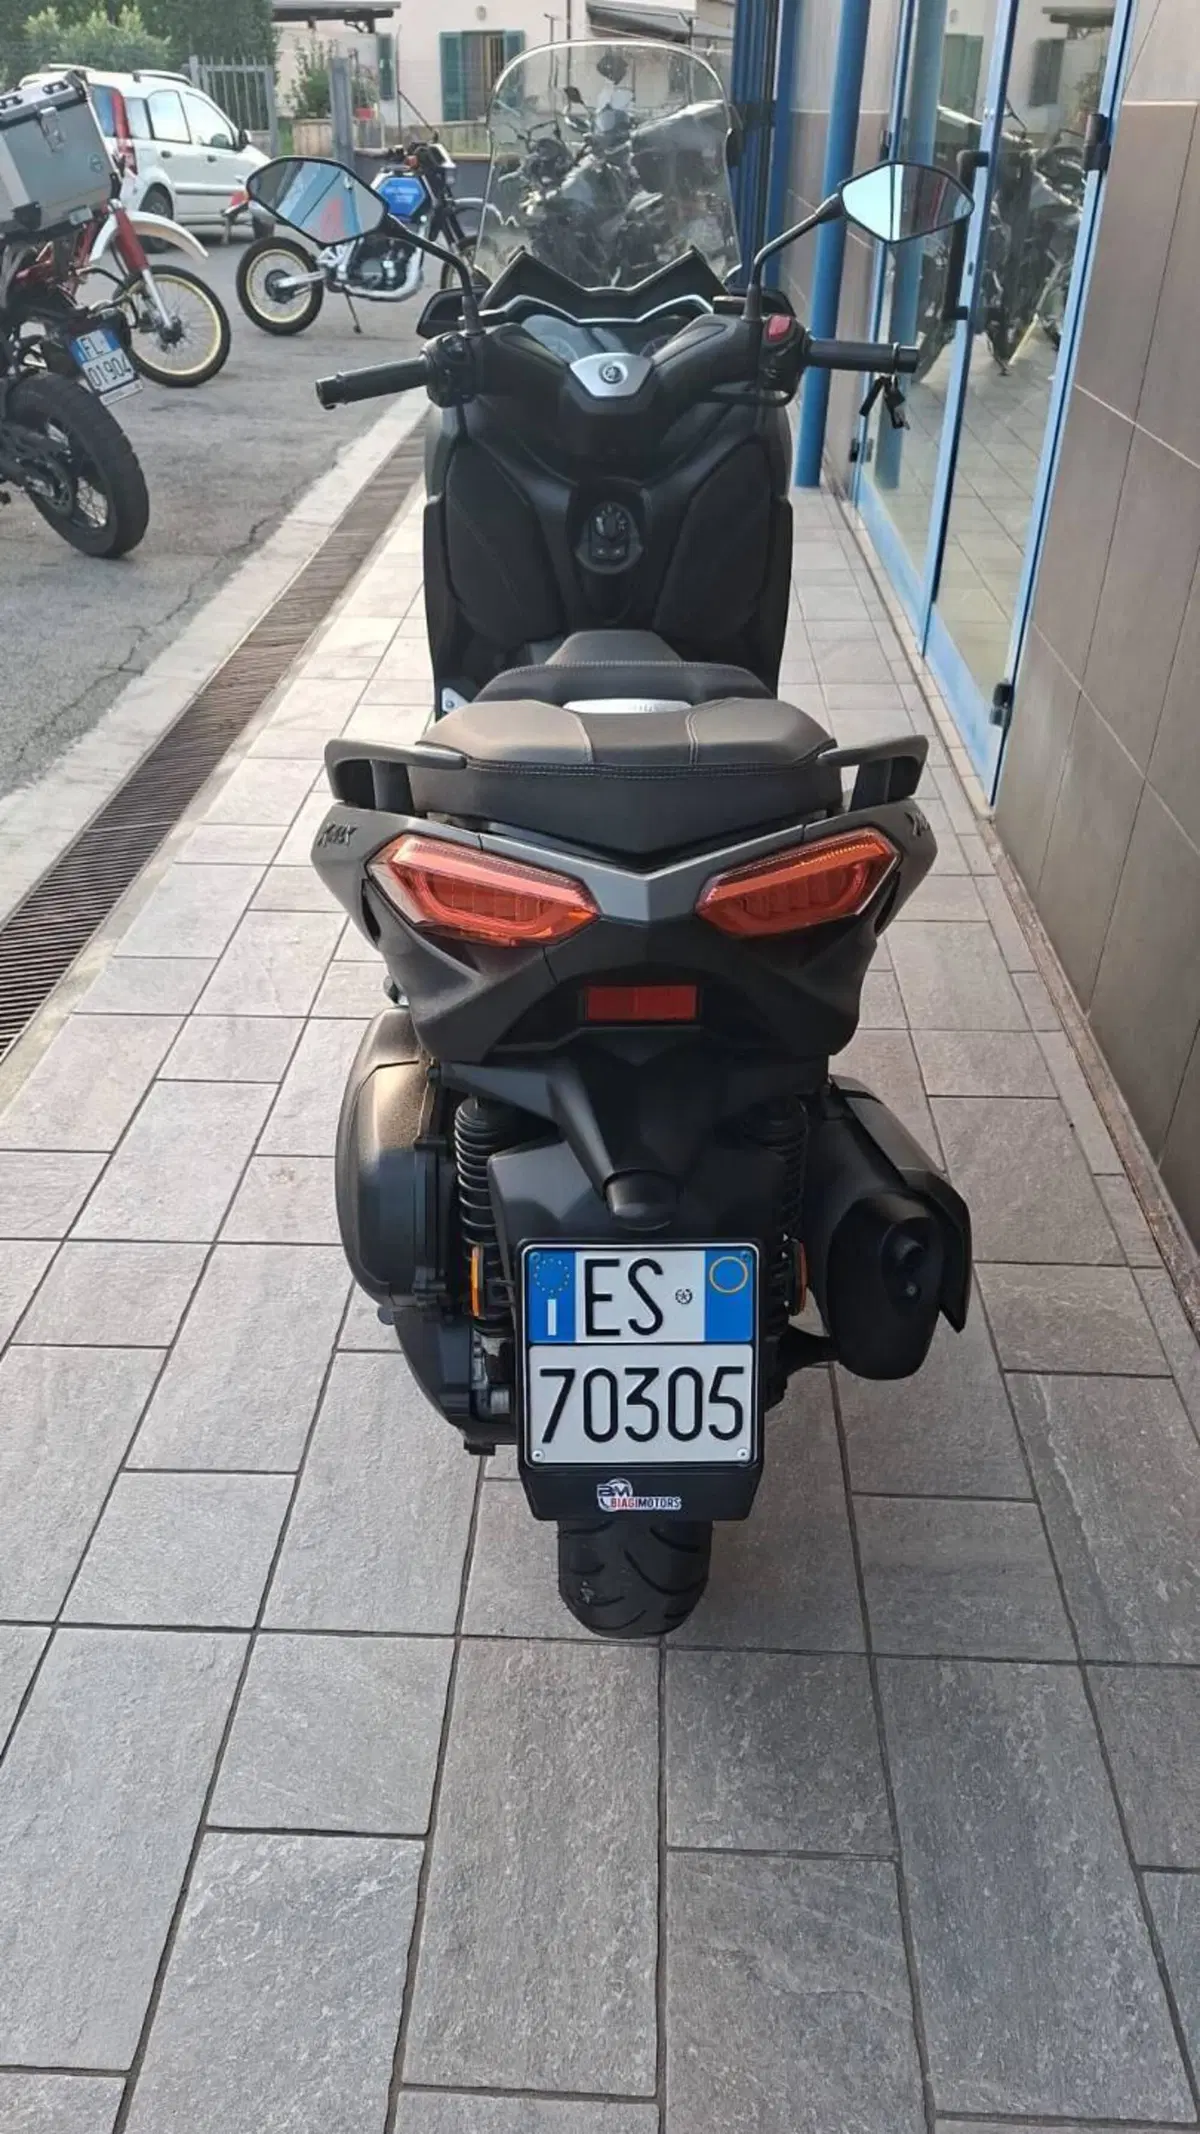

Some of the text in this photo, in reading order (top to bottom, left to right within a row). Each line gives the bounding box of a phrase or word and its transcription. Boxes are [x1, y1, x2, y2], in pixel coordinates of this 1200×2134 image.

[80, 336, 104, 358] FL
[88, 353, 132, 387] 01904
[584, 1258, 664, 1336] ES
[540, 1366, 744, 1443] 70305
